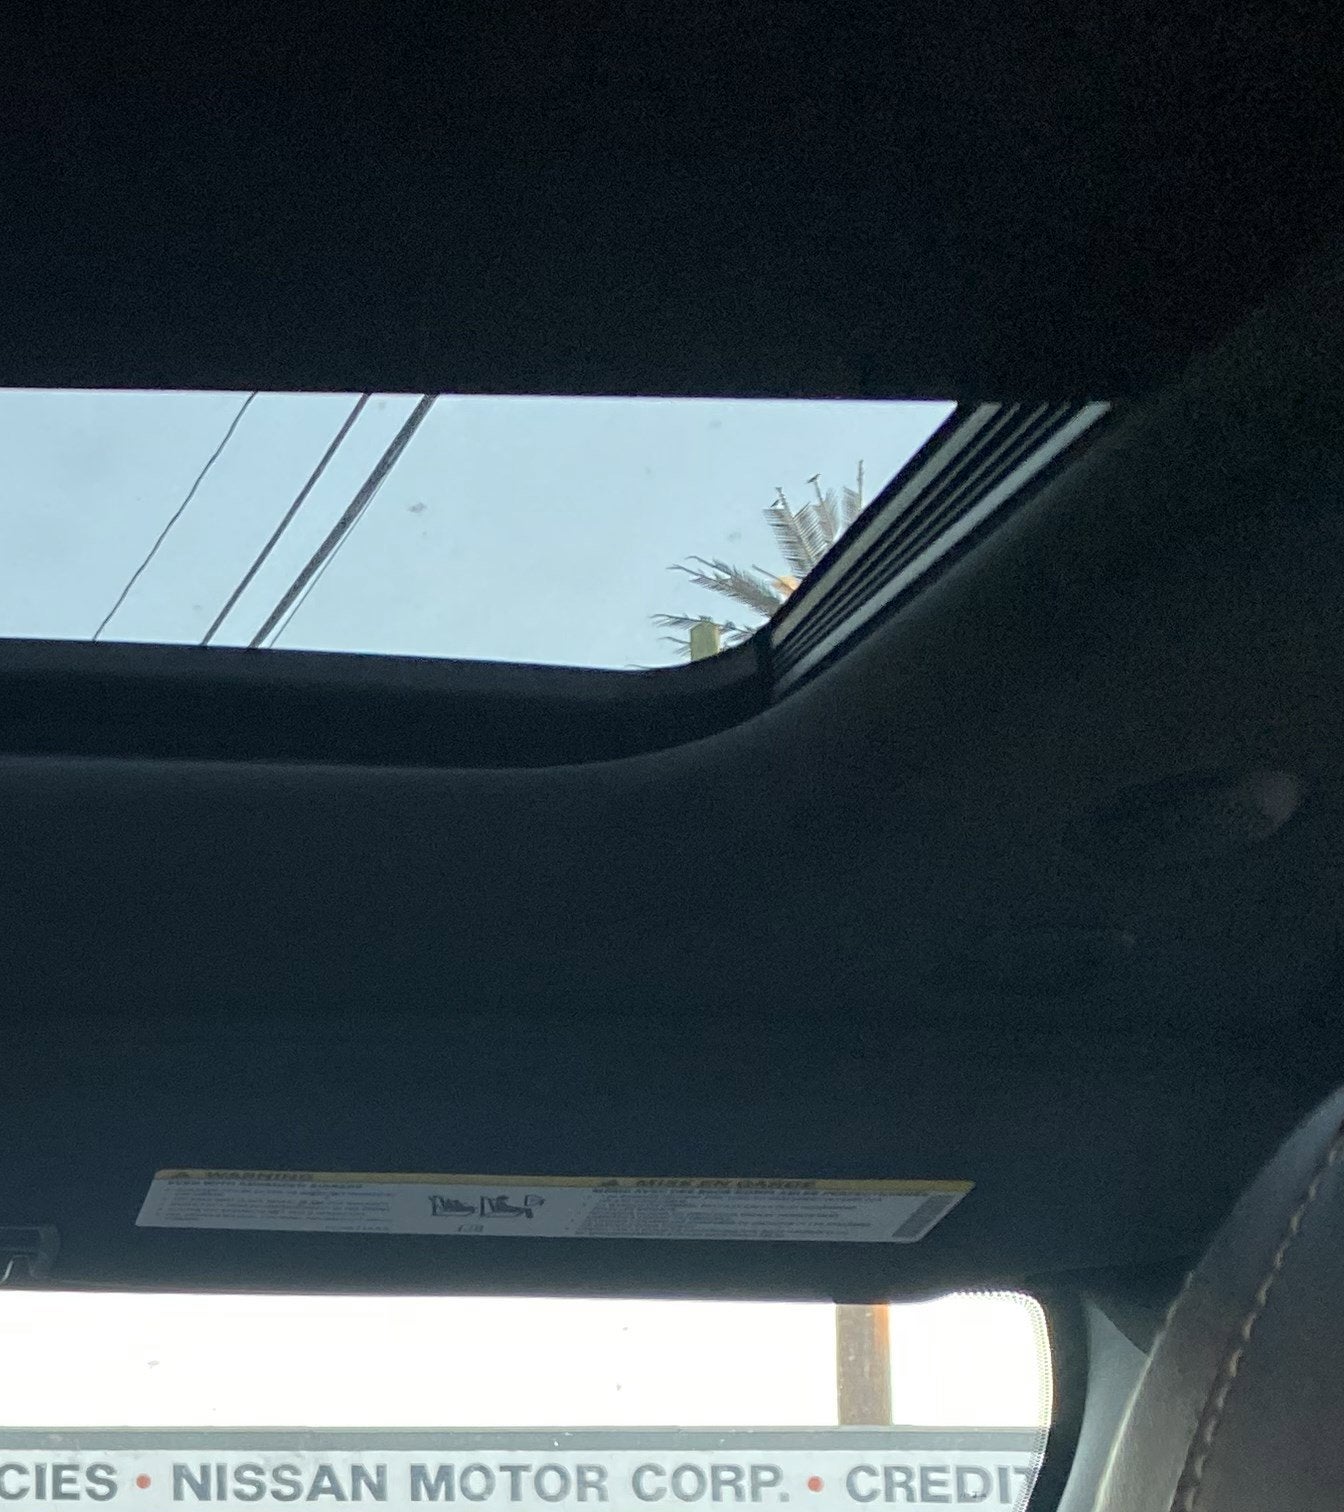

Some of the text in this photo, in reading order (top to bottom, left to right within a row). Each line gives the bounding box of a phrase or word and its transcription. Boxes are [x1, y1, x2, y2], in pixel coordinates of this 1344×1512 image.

[173, 1462, 388, 1501] NISSAN
[411, 1463, 609, 1502] MOTOR
[631, 1463, 791, 1503] CORP.
